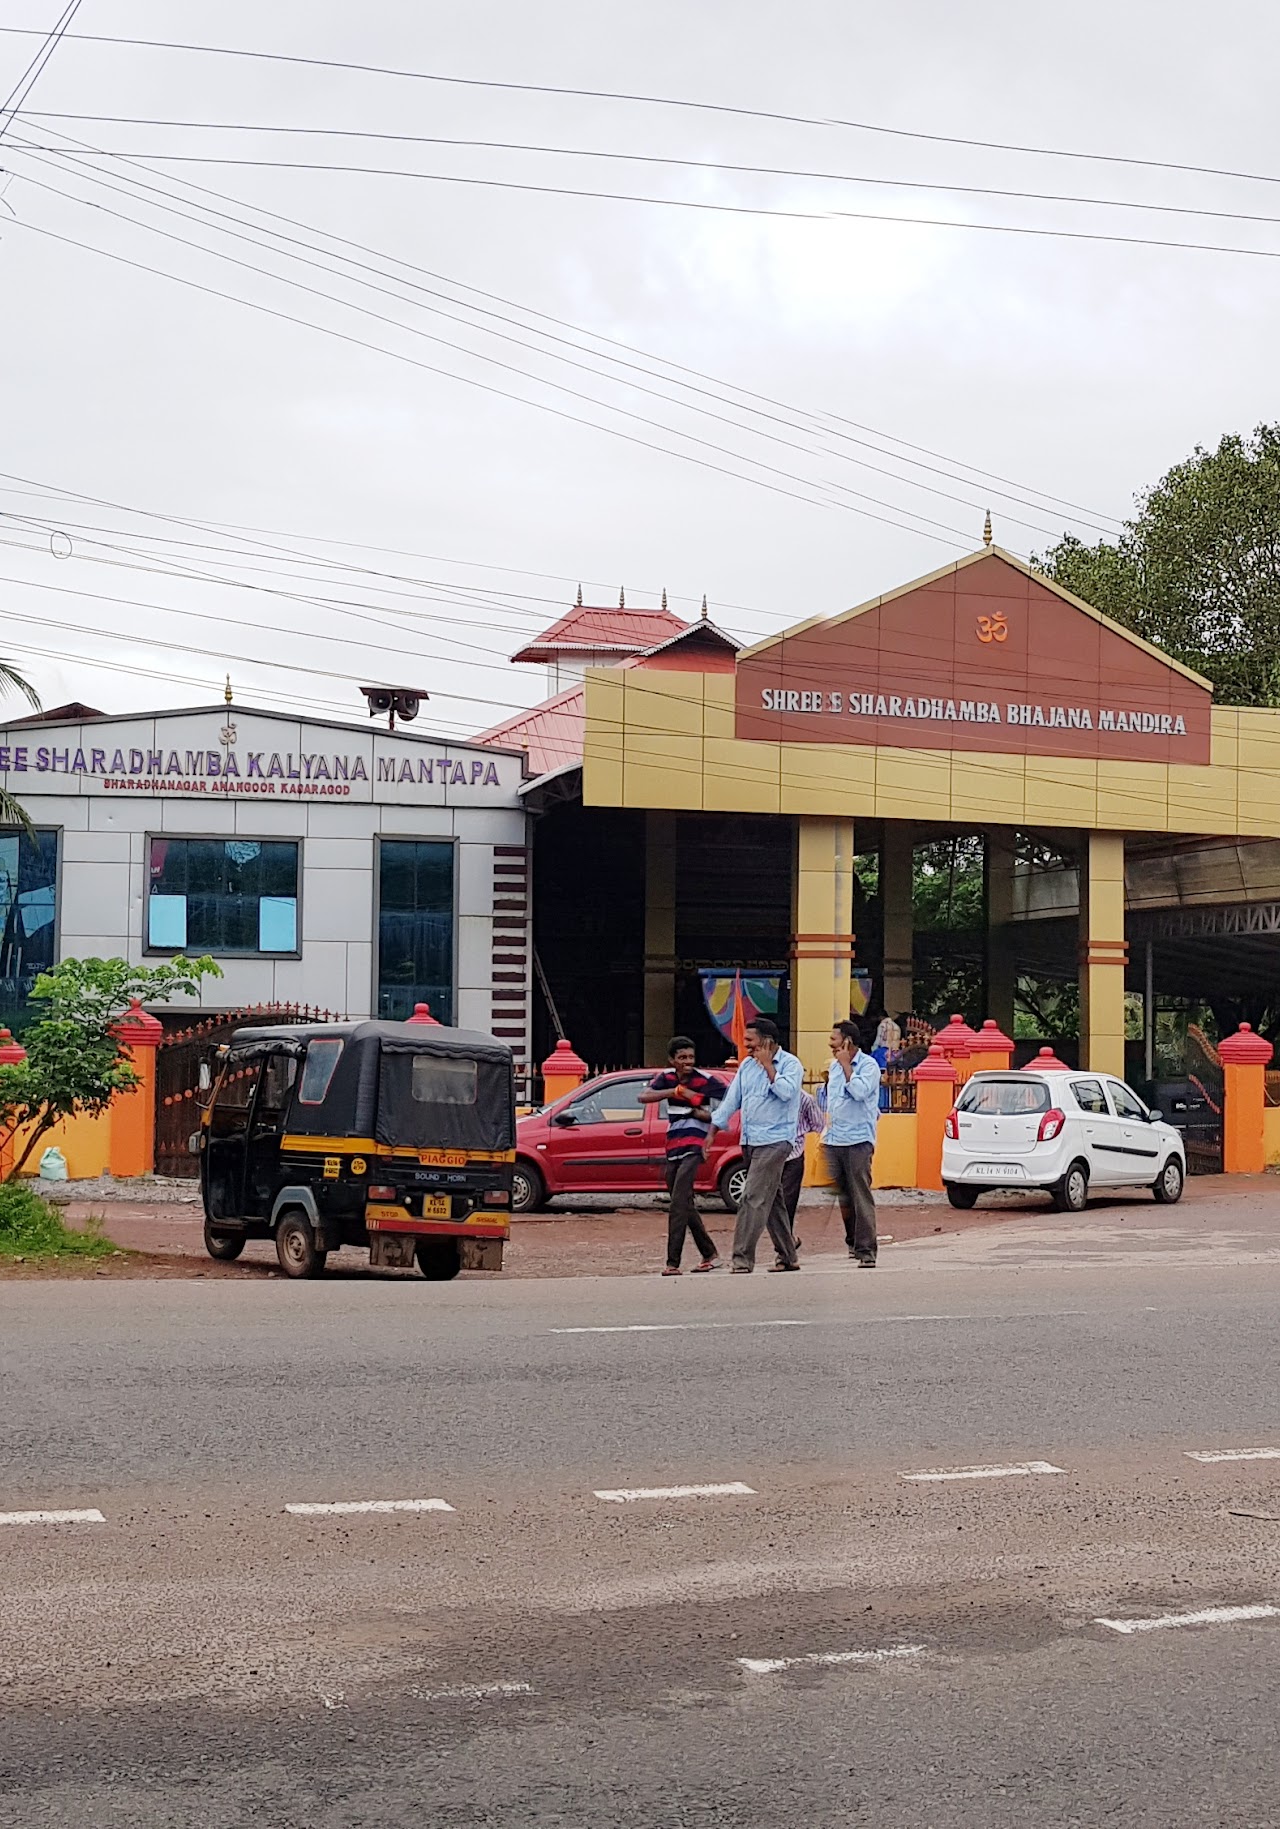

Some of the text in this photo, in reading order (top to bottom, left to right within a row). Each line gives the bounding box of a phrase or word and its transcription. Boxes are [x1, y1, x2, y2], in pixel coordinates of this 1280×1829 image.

[849, 692, 1002, 725] SHARADHAMBA
[1006, 703, 1094, 730] BHAJANA
[1097, 710, 1187, 736] MANDIRA
[35, 747, 240, 777] SHARADHAMBA
[247, 752, 369, 781] KALYANA
[377, 756, 501, 786] MANTAPA
[103, 778, 207, 792] SHARADHANAGAR
[280, 783, 350, 796] KASARAGOD
[421, 1154, 465, 1165] PIAGGIO
[415, 1172, 466, 1182] SOUND HORN
